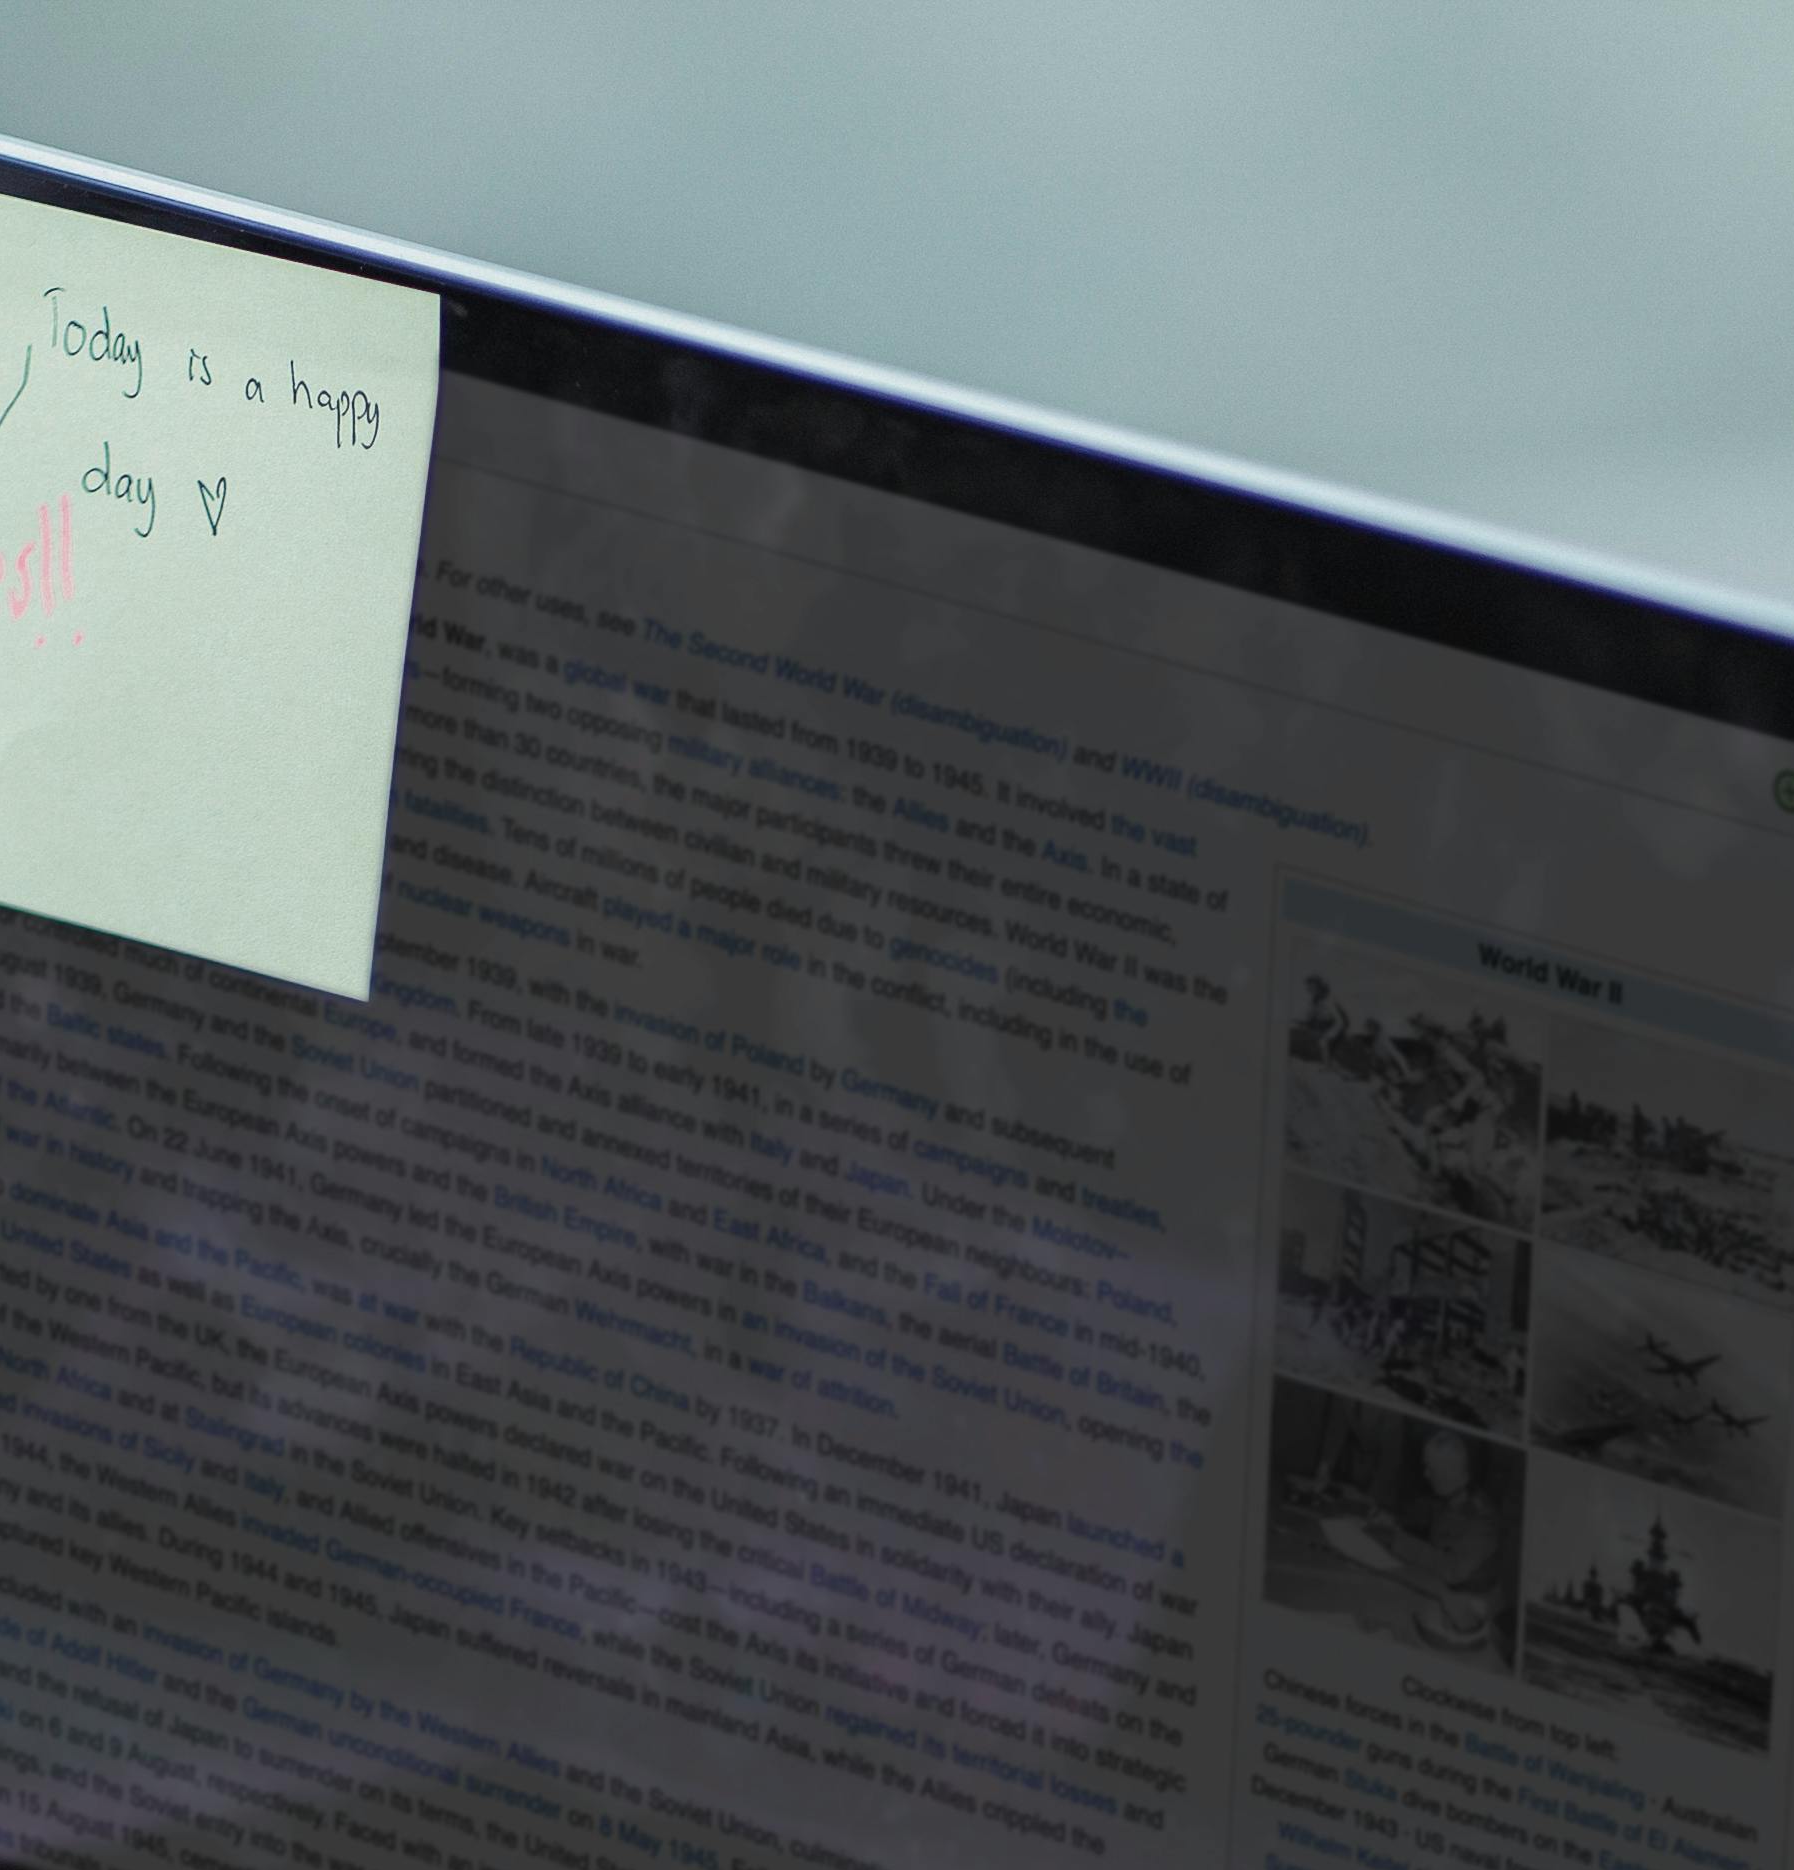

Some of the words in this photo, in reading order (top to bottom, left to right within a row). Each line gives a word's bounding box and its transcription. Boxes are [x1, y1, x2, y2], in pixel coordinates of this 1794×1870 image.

[43, 287, 143, 399] Today
[188, 348, 212, 386] is
[245, 376, 265, 404] a
[290, 360, 380, 450] happy
[81, 441, 156, 538] day
[434, 553, 474, 594] For
[474, 575, 533, 607] other
[534, 593, 590, 628] uses,
[595, 609, 638, 639] see
[842, 674, 886, 707] War
[1071, 745, 1118, 774] and
[441, 619, 492, 659] War,
[497, 641, 541, 671] was
[630, 678, 672, 708] war
[674, 687, 718, 723] that
[720, 700, 787, 741] lasted
[789, 718, 840, 757] from
[846, 736, 900, 773] 1939
[1014, 783, 1107, 833] involved
[1110, 813, 1147, 844] the
[1150, 828, 1198, 858] vast
[599, 940, 640, 969] war.
[1555, 962, 1604, 1000] War
[1262, 1667, 1342, 1712] Chinese
[1343, 1692, 1405, 1732] forces
[1427, 1719, 1461, 1749] the
[1660, 1795, 1760, 1844] Australian
[1400, 1673, 1499, 1725] Clockwise
[1499, 1705, 1546, 1739] from
[1548, 1722, 1582, 1753] top
[1249, 1772, 1348, 1822] December
[1352, 1807, 1400, 1841] 1943
[1262, 1740, 1340, 1784] German
[1400, 1787, 1444, 1818] dive
[1444, 1800, 1530, 1846] bombers
[1561, 1838, 1595, 1867] the
[1365, 1741, 1415, 1772] guns
[1416, 1756, 1480, 1797] during
[1480, 1775, 1514, 1804] the
